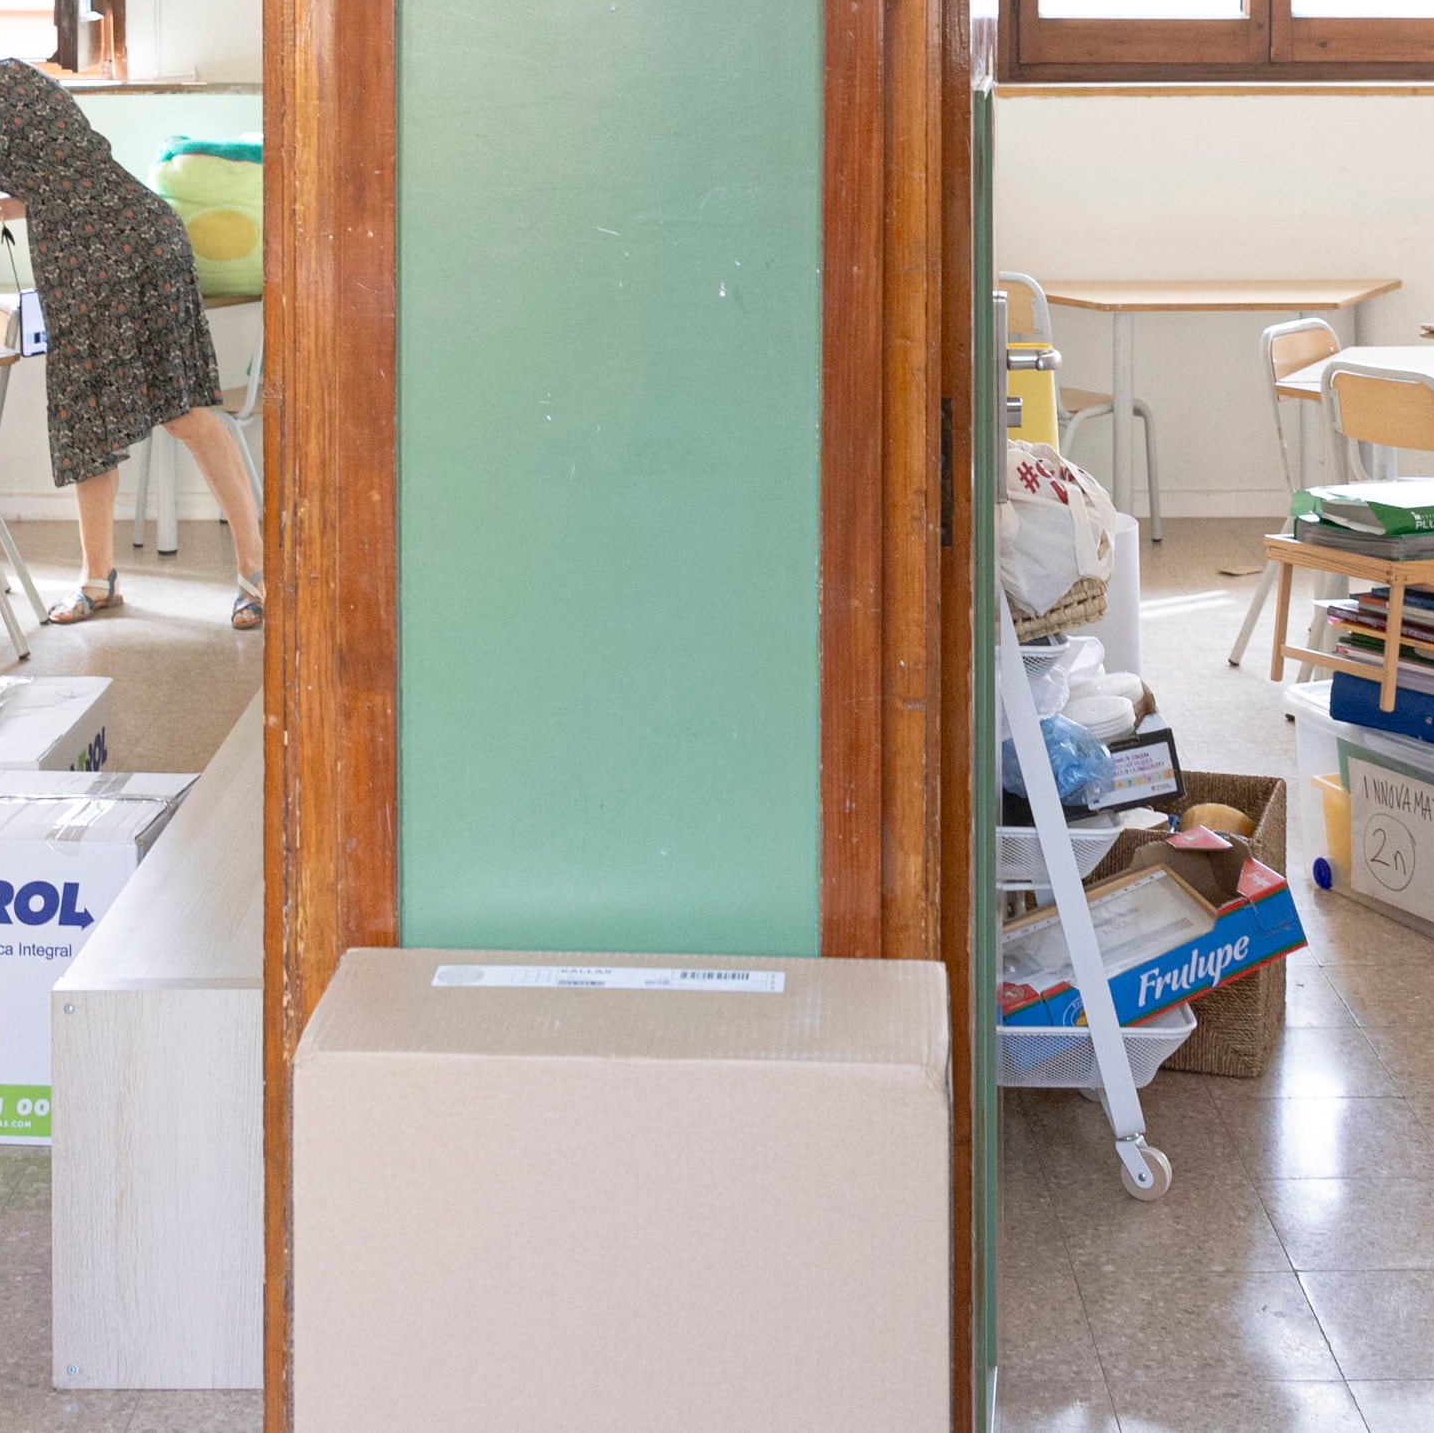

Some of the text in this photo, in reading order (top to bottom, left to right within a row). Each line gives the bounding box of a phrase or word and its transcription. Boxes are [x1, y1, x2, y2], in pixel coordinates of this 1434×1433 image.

[18, 942, 73, 960] Integral
[1138, 935, 1250, 1007] Frulupe
[17, 1098, 51, 1117] 00
